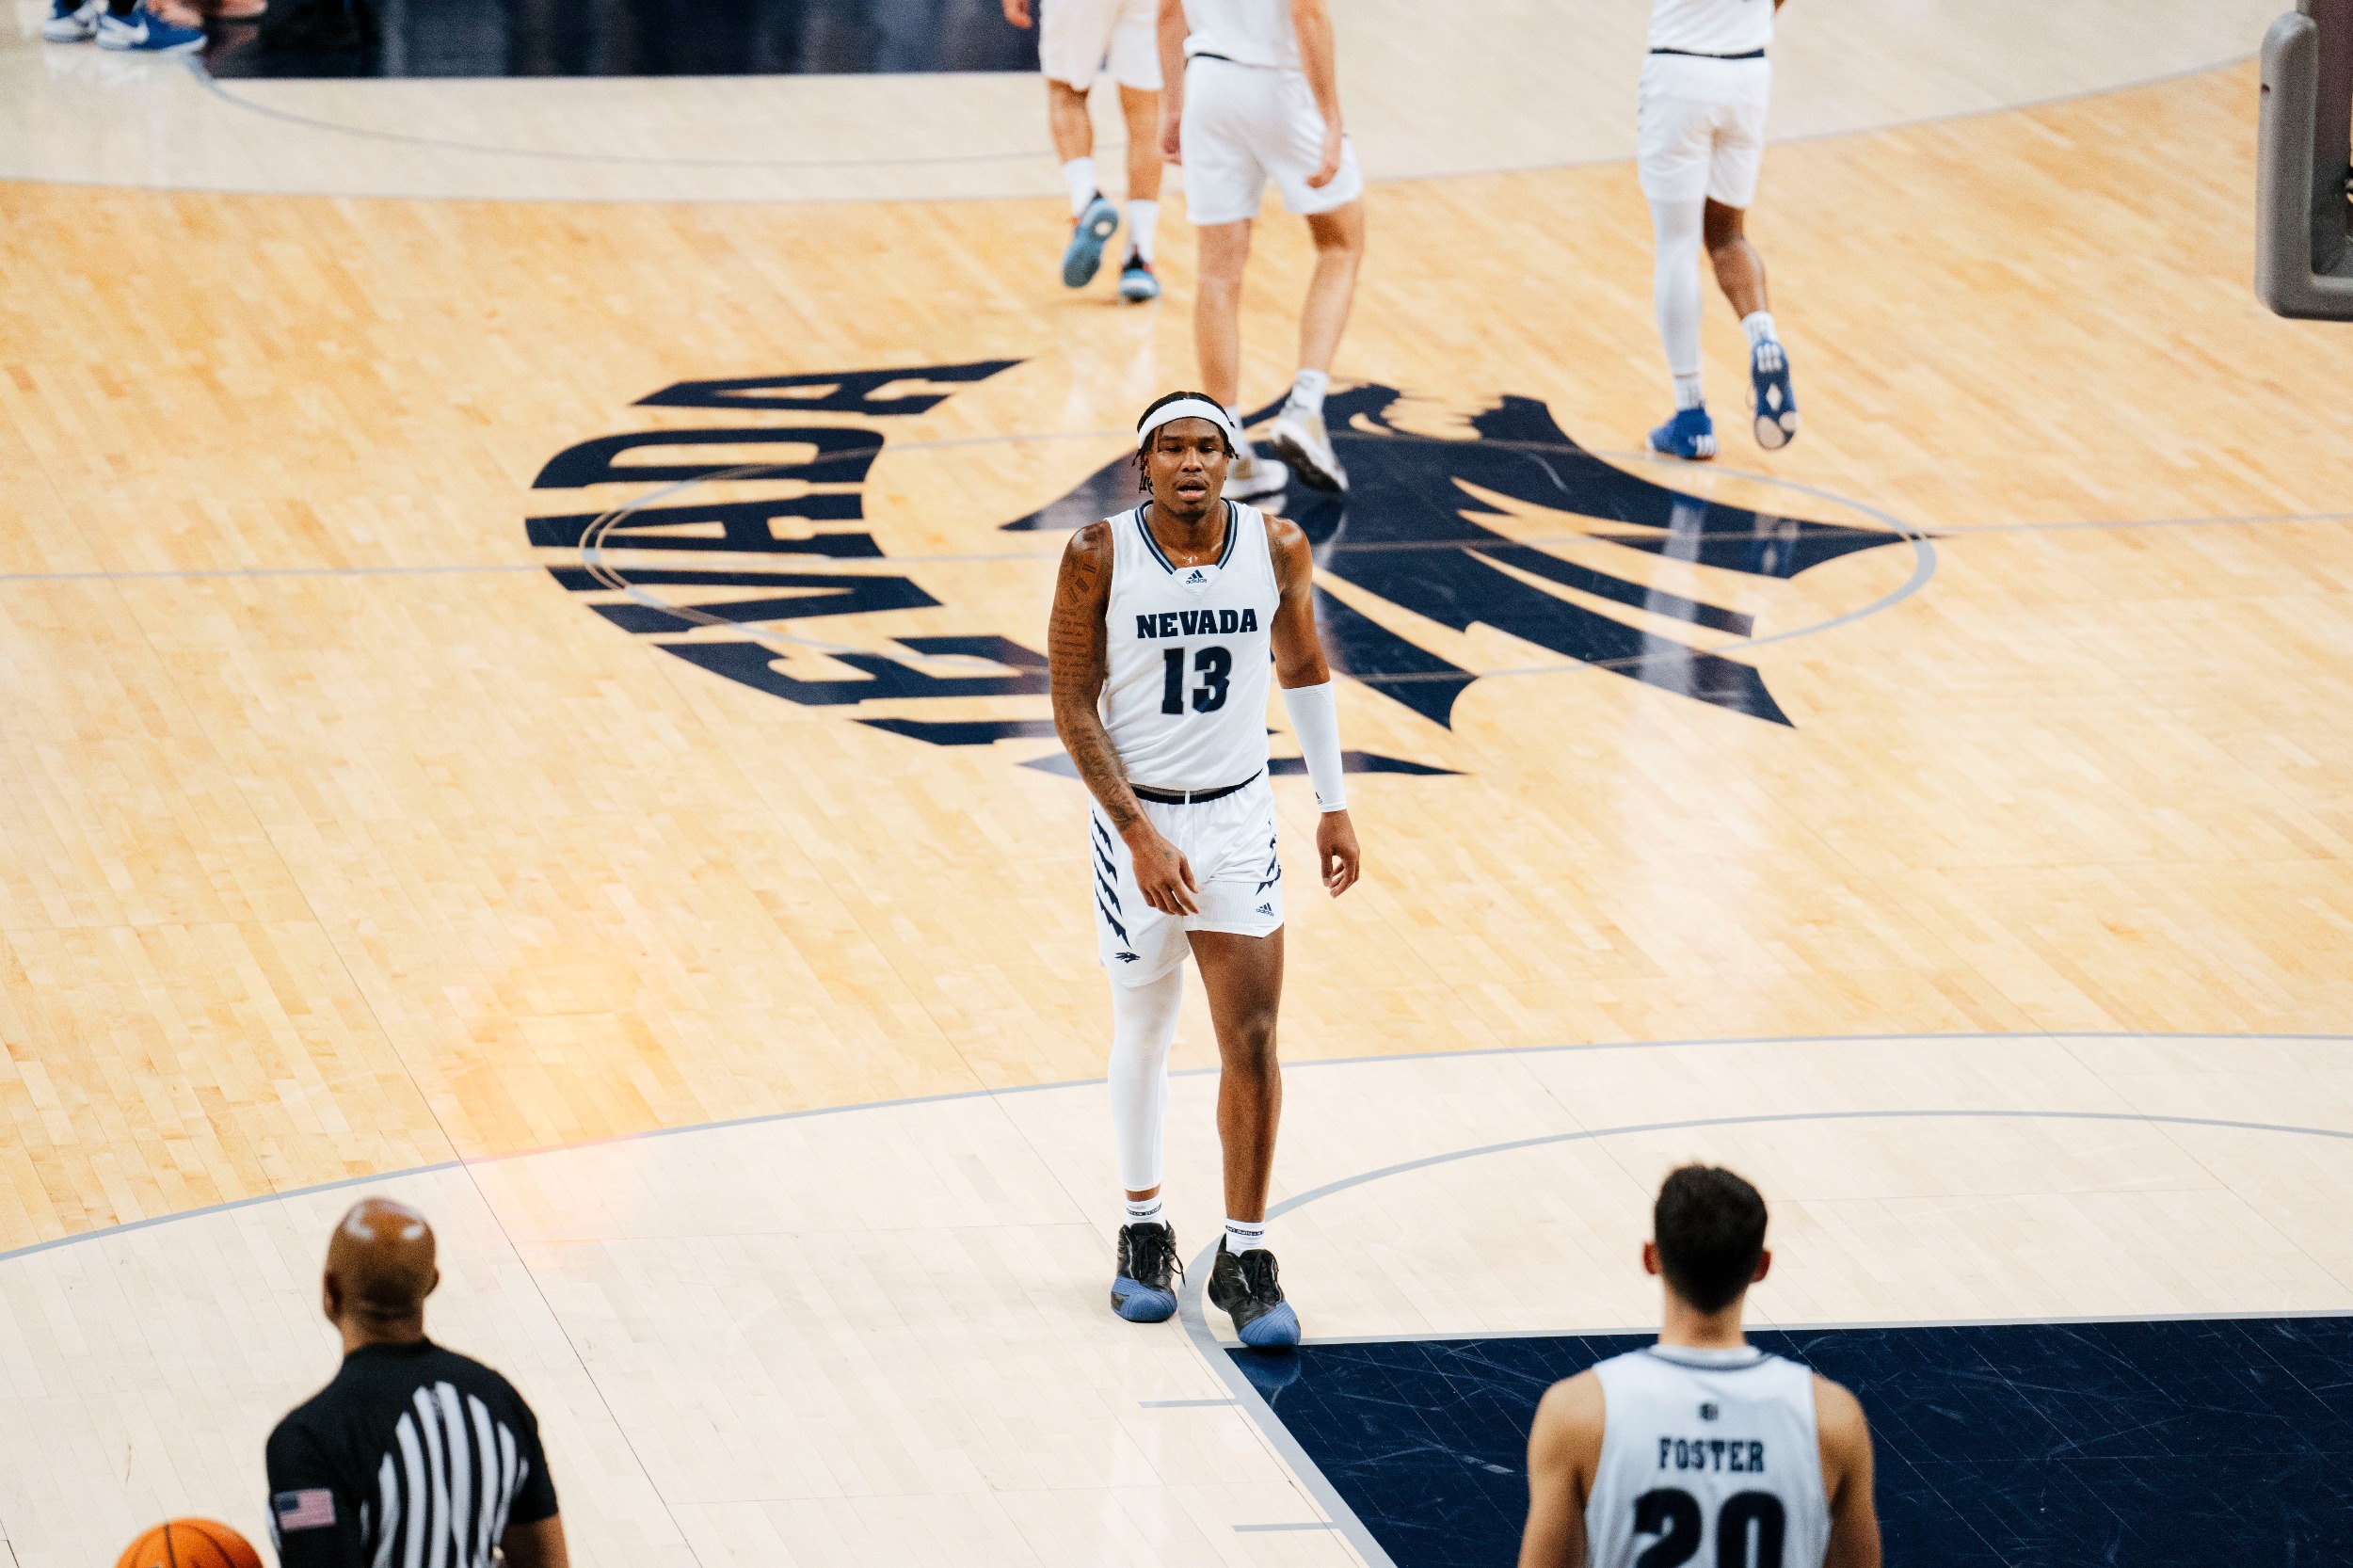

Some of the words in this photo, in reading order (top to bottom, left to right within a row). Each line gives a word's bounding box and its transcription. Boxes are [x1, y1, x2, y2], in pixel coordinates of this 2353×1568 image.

[1136, 608, 1258, 639] NEVADA
[1160, 646, 1232, 715] 13
[1658, 1437, 1765, 1473] FOSTER
[1633, 1487, 1786, 1568] 20
